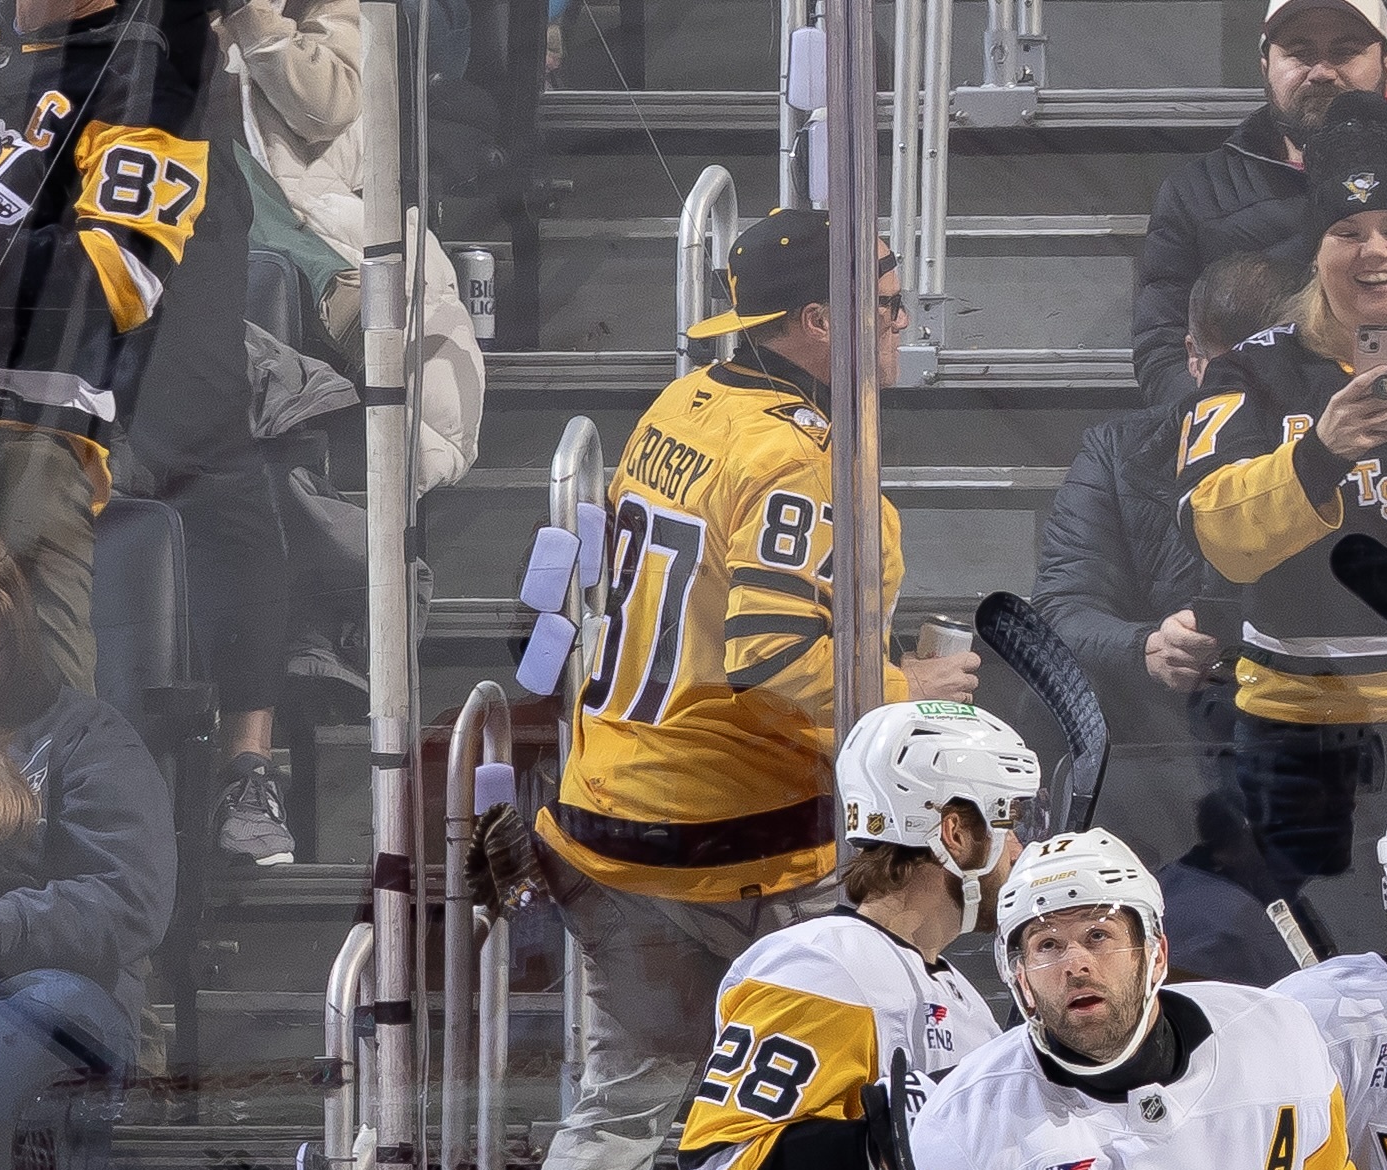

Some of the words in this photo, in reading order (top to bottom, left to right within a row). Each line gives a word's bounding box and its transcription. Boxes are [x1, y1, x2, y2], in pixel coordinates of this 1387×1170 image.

[97, 144, 202, 228] 87
[625, 424, 714, 506] CROSBY
[921, 703, 976, 717] MSA
[1039, 839, 1085, 858] 17
[1029, 869, 1078, 889] BAUER
[696, 1022, 822, 1124] 28
